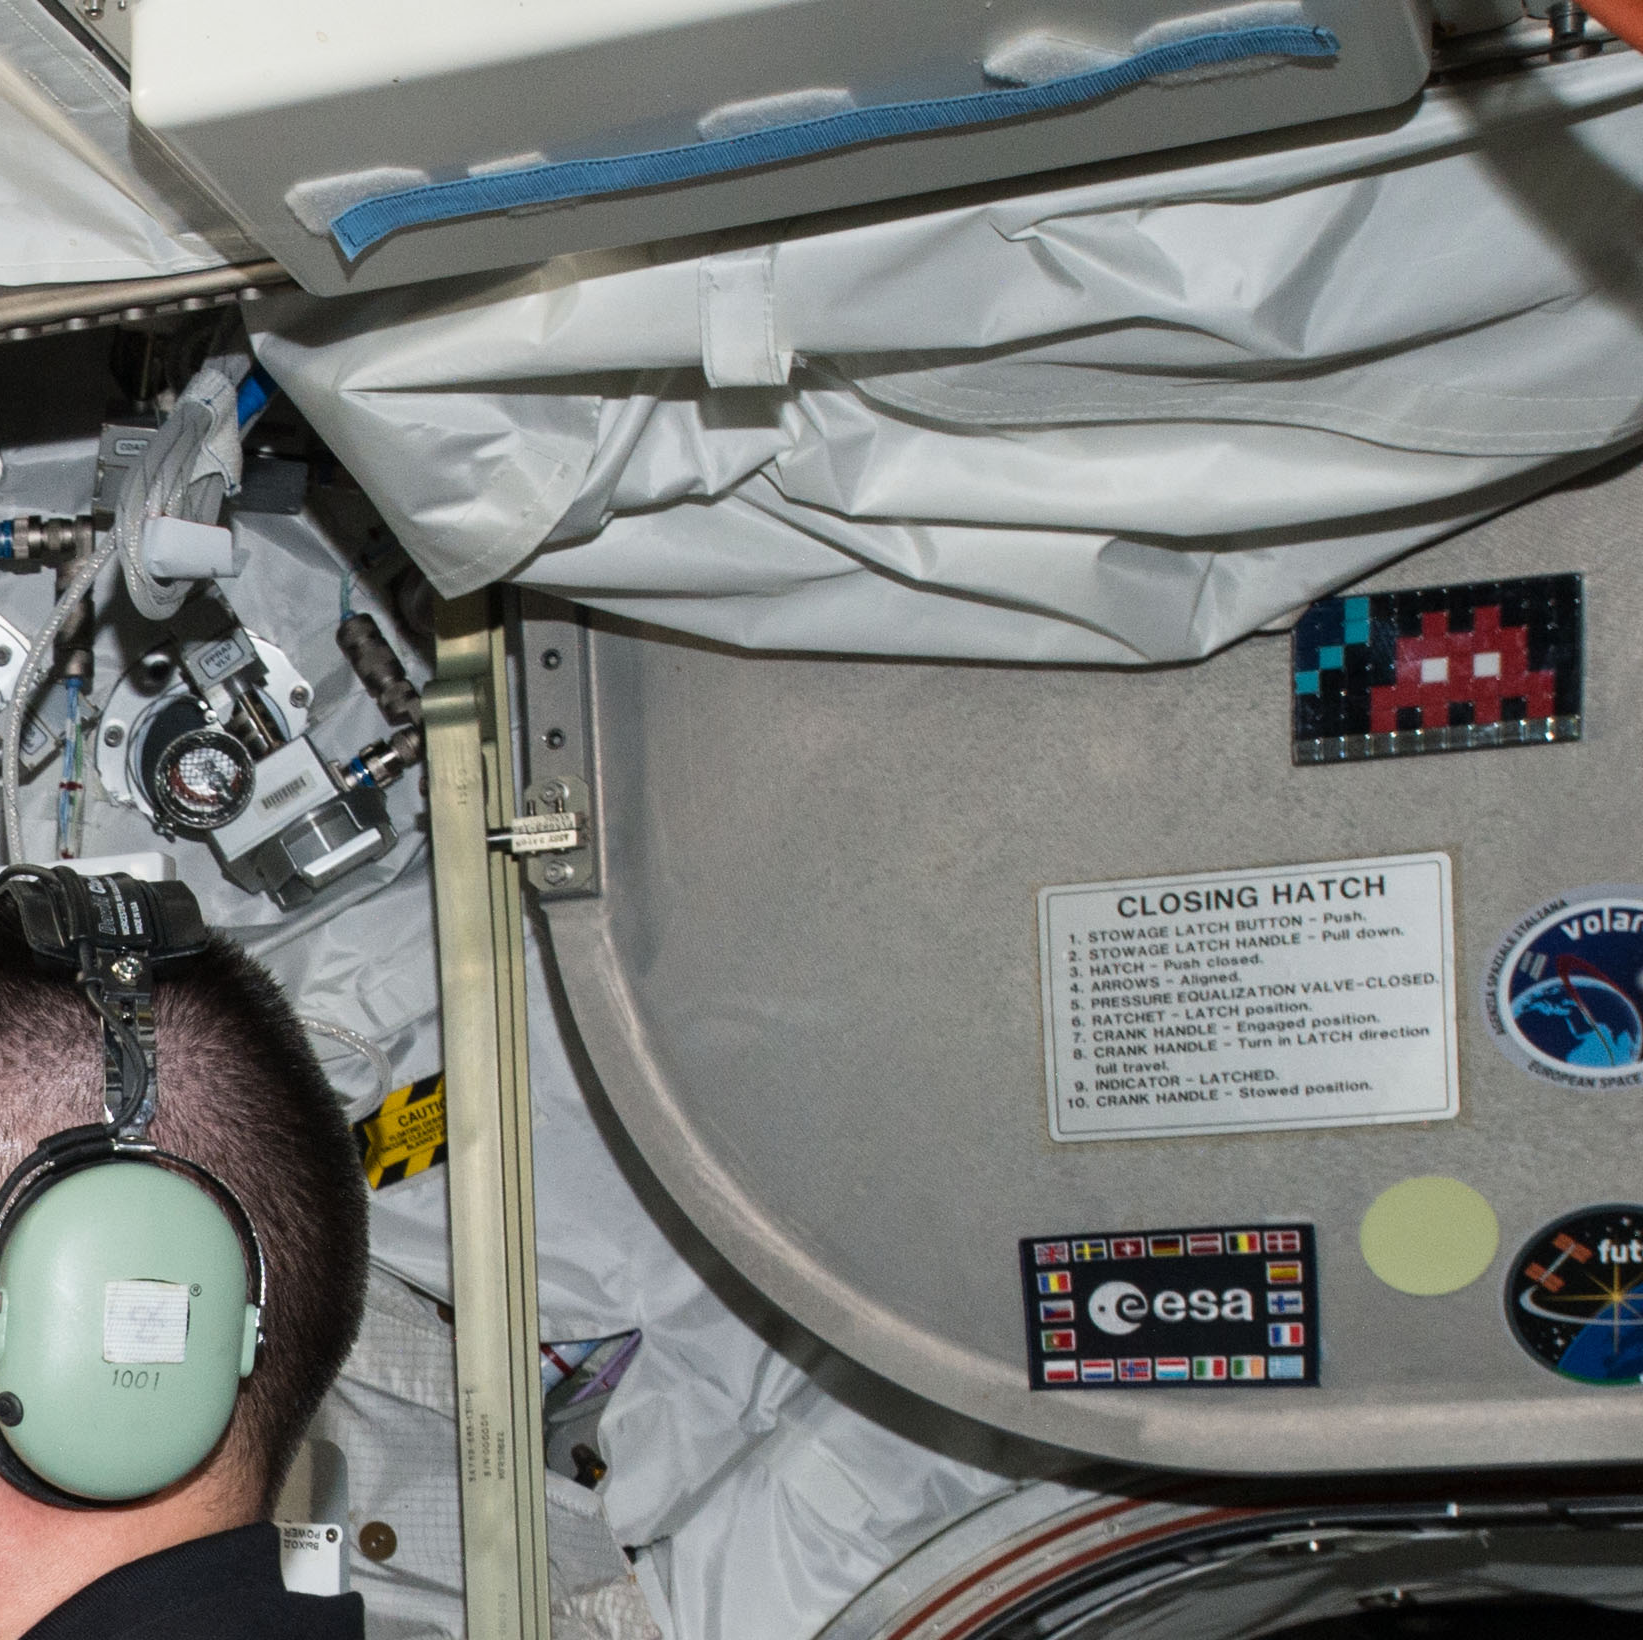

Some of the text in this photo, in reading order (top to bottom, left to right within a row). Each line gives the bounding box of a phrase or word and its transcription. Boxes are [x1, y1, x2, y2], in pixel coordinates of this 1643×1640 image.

[1117, 874, 1385, 918] CLOSING HATCH
[1087, 926, 1169, 944] STOWAGE
[1175, 921, 1230, 938] LATCH
[1235, 915, 1303, 932] BUTTON
[1322, 911, 1367, 924] Push.
[1517, 899, 1568, 938] ITALIANA
[1088, 944, 1170, 961] STOWAGE
[1175, 938, 1230, 955] LATCH
[1236, 933, 1301, 950] HANDLE
[1322, 929, 1350, 942] Pull
[1355, 926, 1405, 940] down.
[1089, 961, 1145, 978] HATCH
[1164, 956, 1200, 971] Push
[1207, 953, 1264, 968] closed.
[1091, 976, 1160, 993] ARROWS
[1180, 971, 1242, 987] Aligned.
[1091, 992, 1173, 1009] PRESSURE
[1176, 983, 1296, 1003] EQUALIZATION
[1301, 972, 1440, 994] VALVE-CLOSED.
[1092, 1010, 1164, 1027] RATCHET
[1185, 1003, 1240, 1020] LATCH
[1245, 1001, 1313, 1017] position.
[1093, 1026, 1147, 1043] CRANK
[1153, 1023, 1217, 1038] HANDLE
[1236, 1018, 1306, 1034] Engaged
[1311, 1013, 1381, 1029] position.
[1093, 1043, 1147, 1059] CRANK
[1154, 1039, 1218, 1055] HANDLE
[1237, 1036, 1272, 1050] Turn
[1277, 1034, 1291, 1046] in
[1296, 1028, 1353, 1046] LATCH
[1359, 1025, 1430, 1042] direction
[1095, 1074, 1181, 1091] INDICATOR
[1199, 1069, 1279, 1086] LATCHED.
[1096, 1060, 1170, 1075] full travel.
[1527, 1059, 1642, 1089] EUROPEAN SPACE
[1096, 1092, 1150, 1108] CRANK
[1156, 1088, 1218, 1104] HANDLE
[1239, 1084, 1299, 1099] Stowed
[1305, 1080, 1373, 1096] position.
[397, 1100, 445, 1128] CAUTI
[1597, 1238, 1643, 1264] fut
[1151, 1287, 1254, 1322] esa
[113, 1369, 160, 1392] 1001
